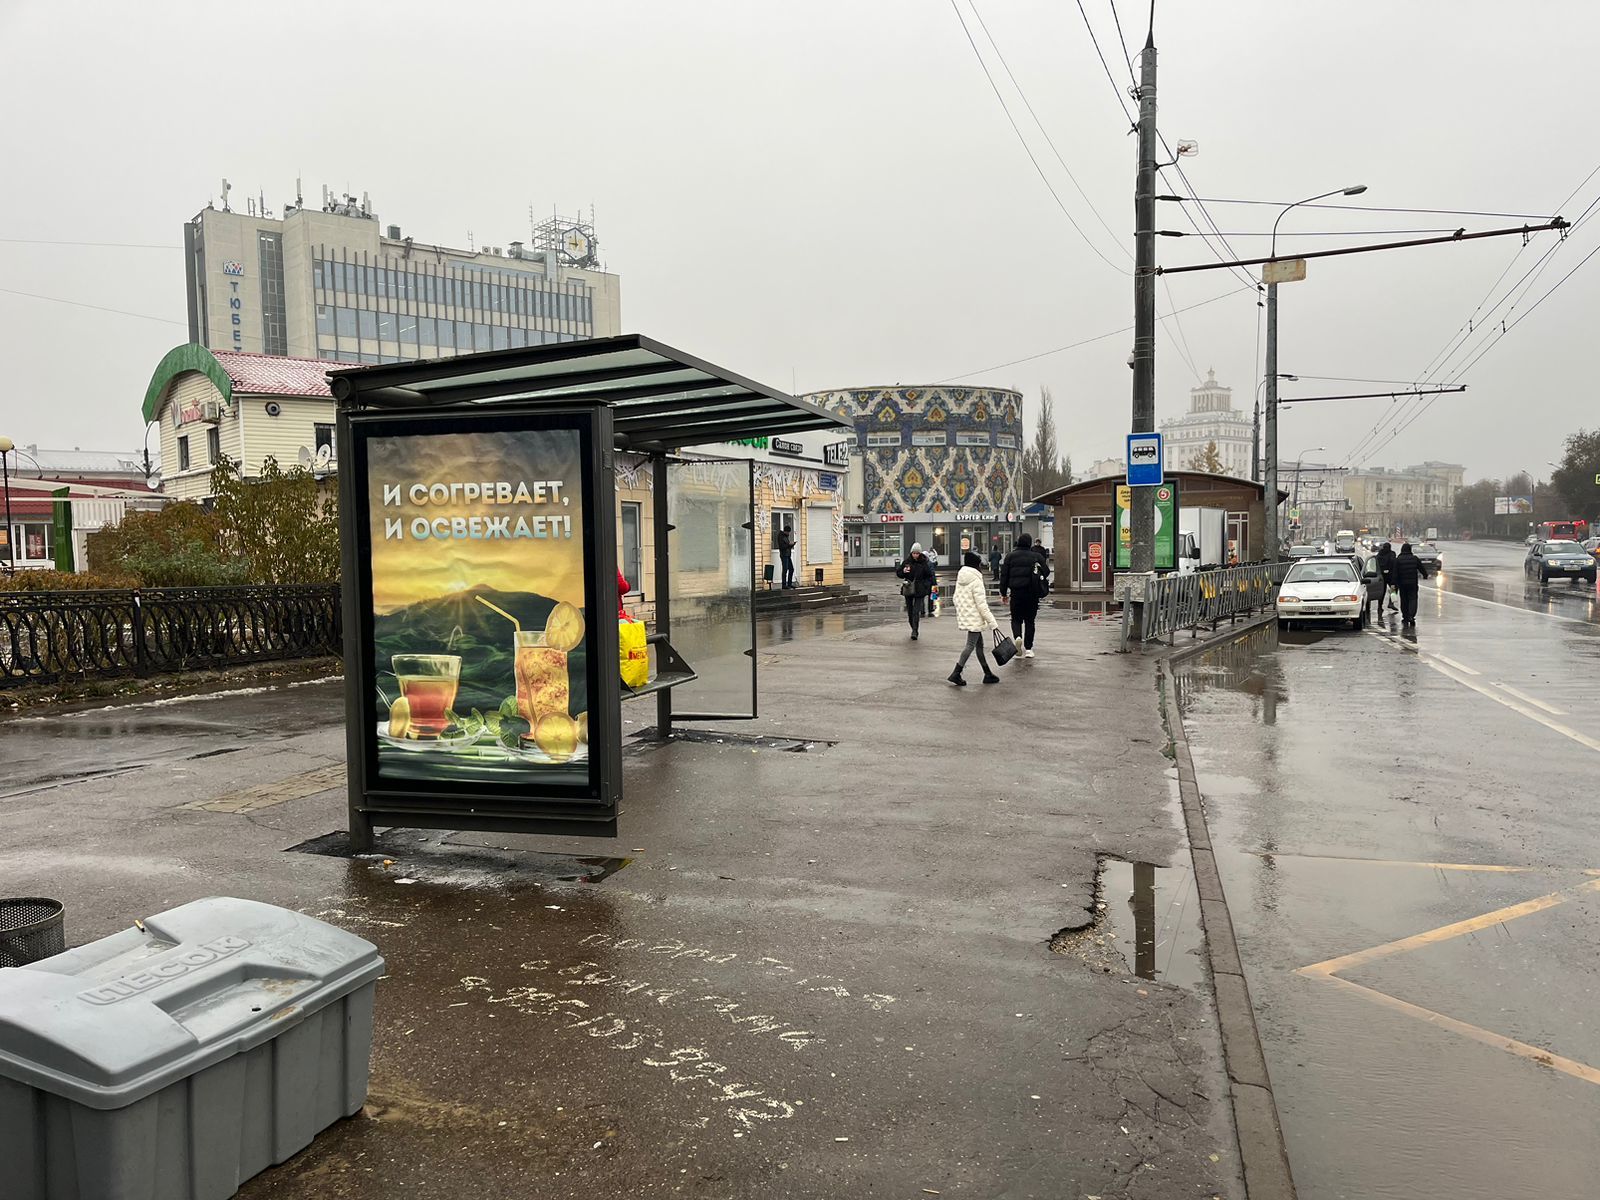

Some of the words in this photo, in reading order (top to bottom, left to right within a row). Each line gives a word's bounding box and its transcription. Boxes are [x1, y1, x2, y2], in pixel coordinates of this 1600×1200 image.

[383, 484, 401, 506] И
[408, 481, 570, 506] СОГРЕВАЕТ,
[385, 517, 403, 540] И
[410, 515, 572, 540] ОСВЕЖАЕТ!
